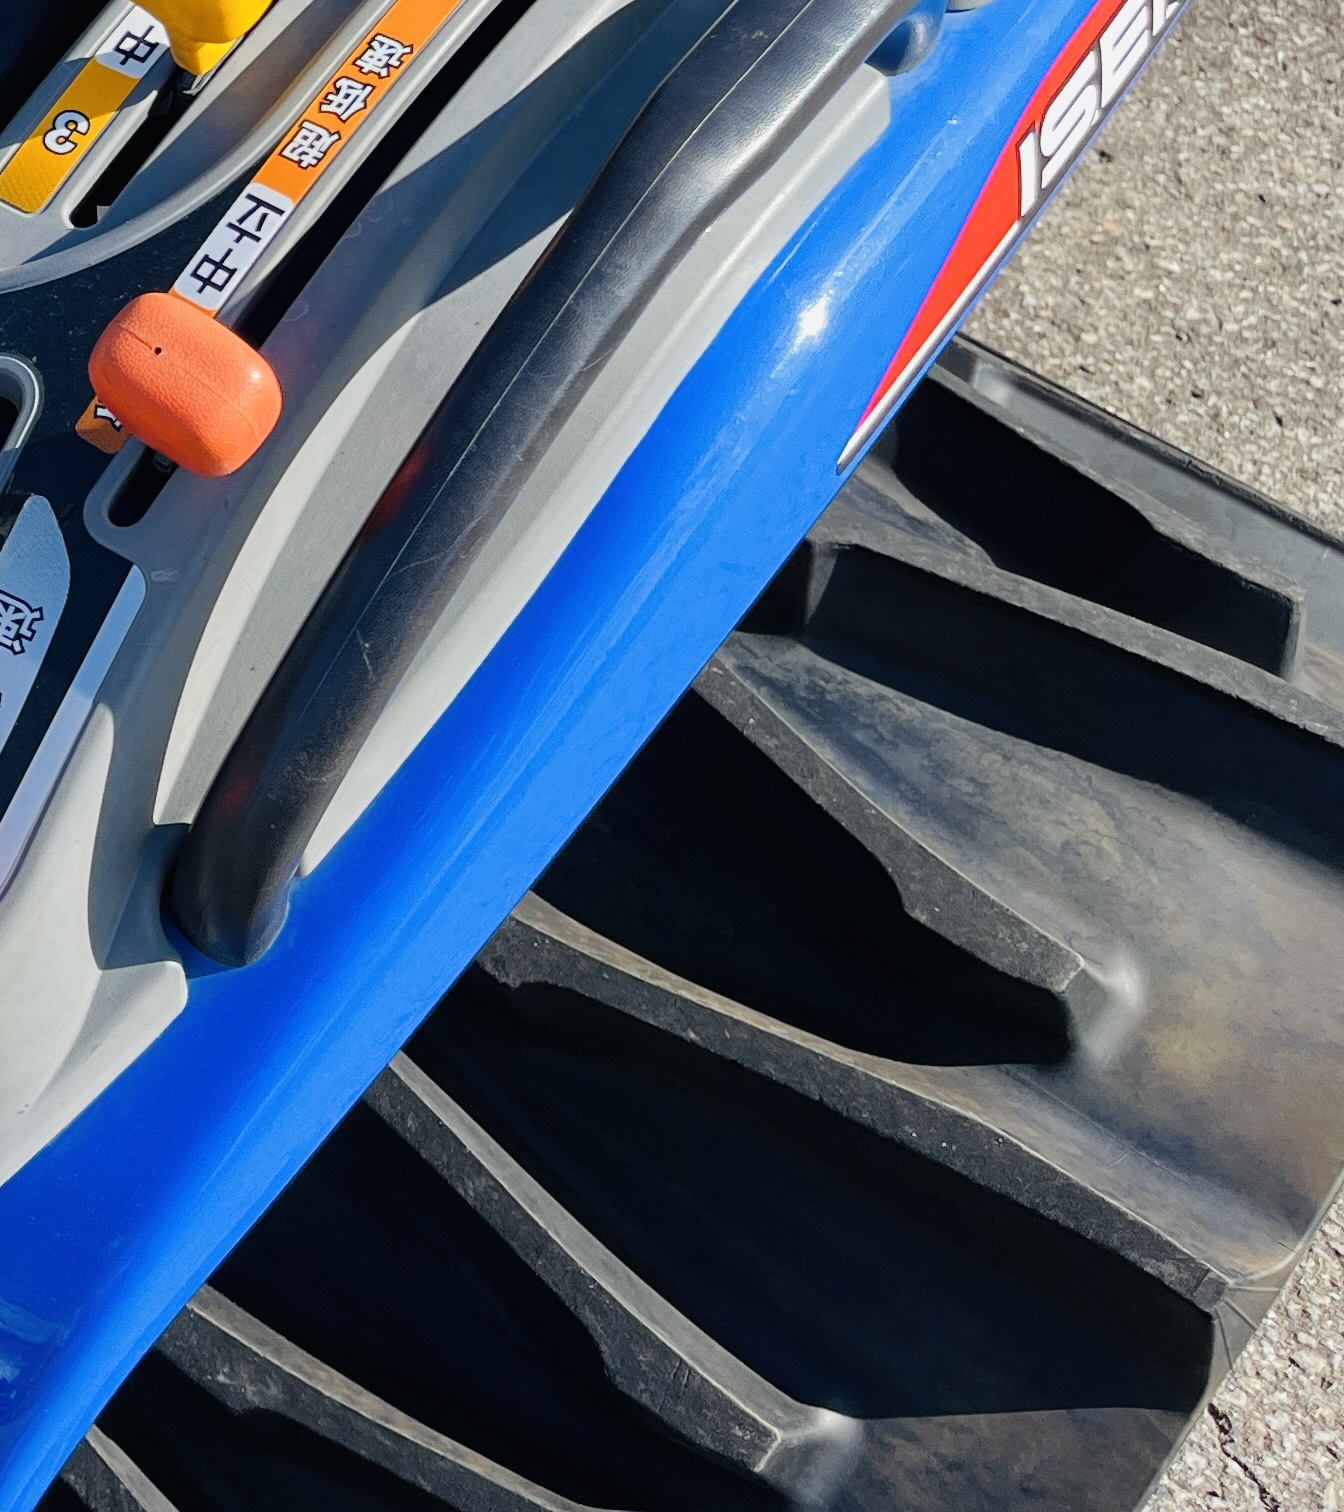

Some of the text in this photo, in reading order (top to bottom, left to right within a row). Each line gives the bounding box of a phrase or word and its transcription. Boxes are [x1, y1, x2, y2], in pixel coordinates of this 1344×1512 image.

[42, 108, 91, 155] 3
[280, 32, 415, 170] 超低速
[190, 192, 287, 295] 中立
